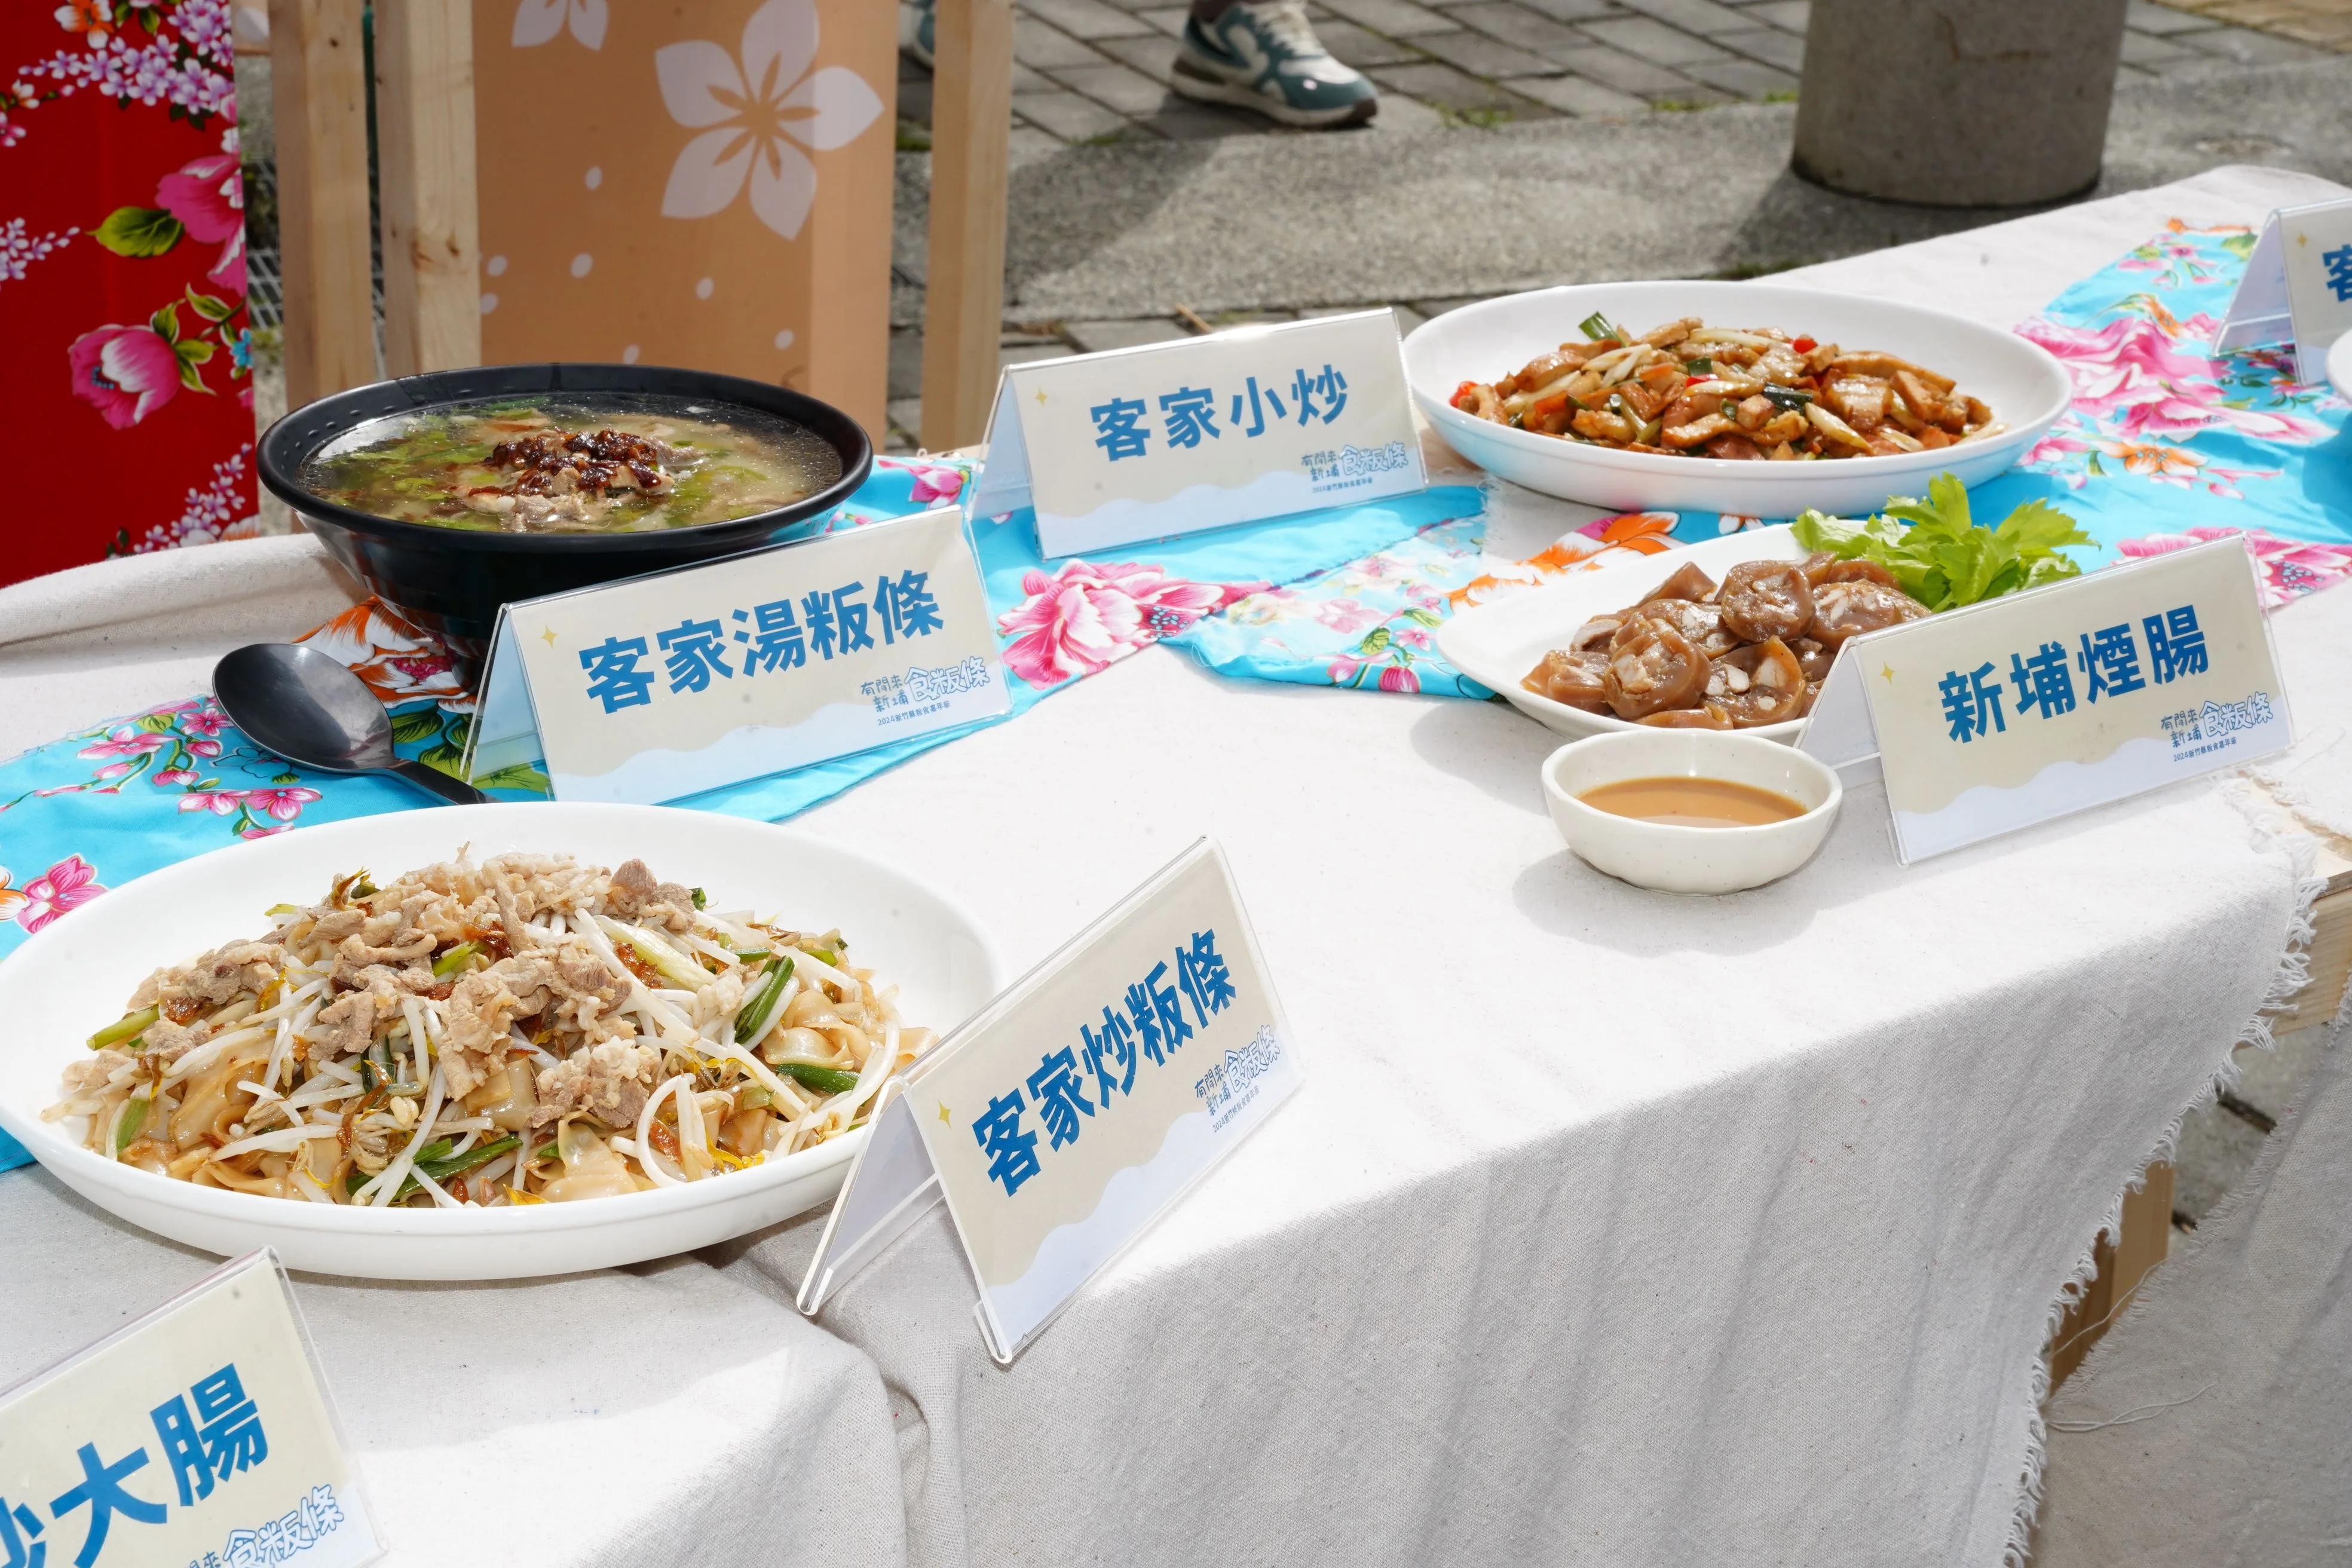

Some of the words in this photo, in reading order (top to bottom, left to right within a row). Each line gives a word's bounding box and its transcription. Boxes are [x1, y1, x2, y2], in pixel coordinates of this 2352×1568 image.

[1090, 365, 1348, 461] 客家小炒
[578, 569, 944, 715] 客家湯粄條
[904, 656, 990, 702] 食粄條
[1938, 605, 2209, 743] 新埔煙腸
[872, 689, 909, 712] 新埔
[2199, 691, 2273, 737] 食粄條
[2170, 724, 2201, 748] 新埔
[971, 929, 1236, 1197] 客家炒粄條
[1206, 1081, 1231, 1116] 新埔
